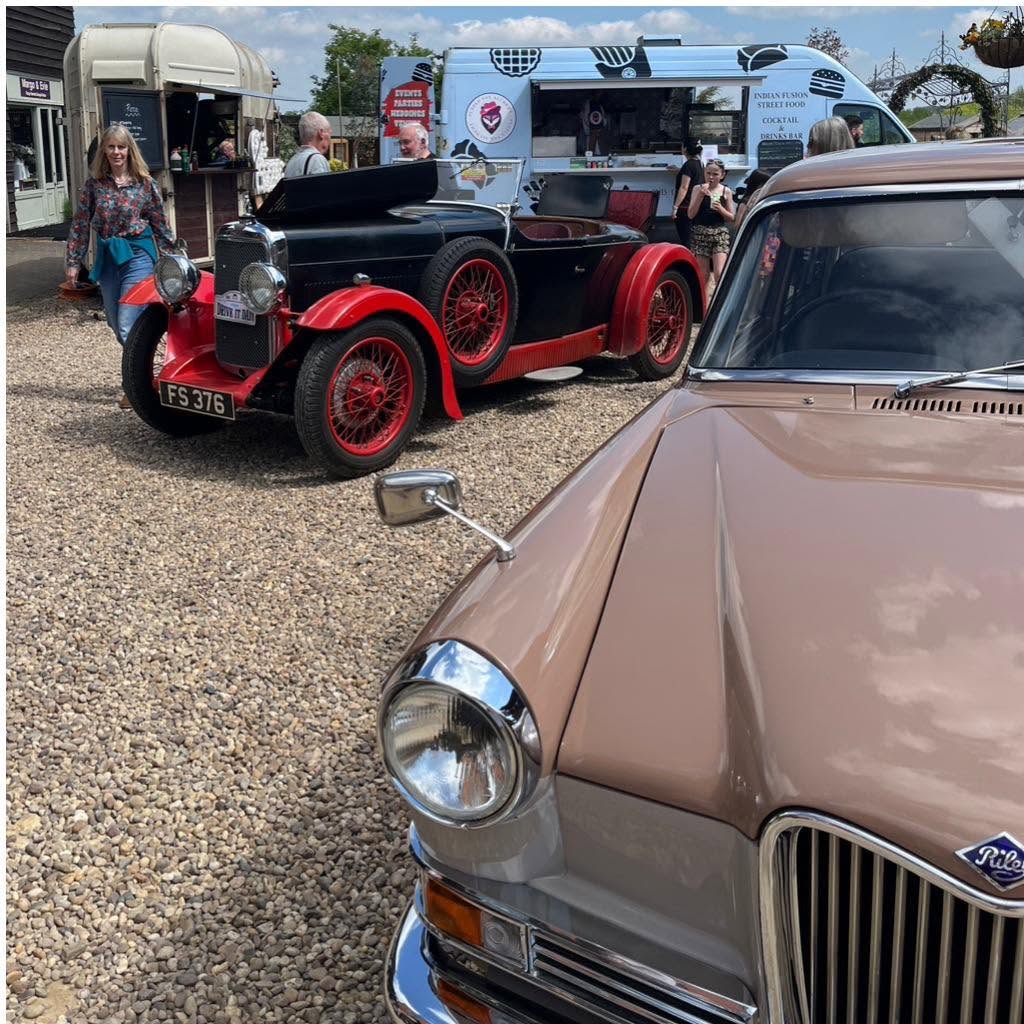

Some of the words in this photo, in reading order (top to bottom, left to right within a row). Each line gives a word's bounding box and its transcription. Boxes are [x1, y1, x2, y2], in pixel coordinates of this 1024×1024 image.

[395, 89, 423, 97] EVENTS
[781, 91, 808, 99] FUSION
[393, 99, 423, 107] PARTIES
[757, 101, 783, 109] STREET
[217, 302, 233, 318] DRIVE
[234, 308, 241, 319] IT
[167, 384, 189, 407] FS
[192, 389, 225, 415] 376
[975, 845, 1024, 873] Rile
